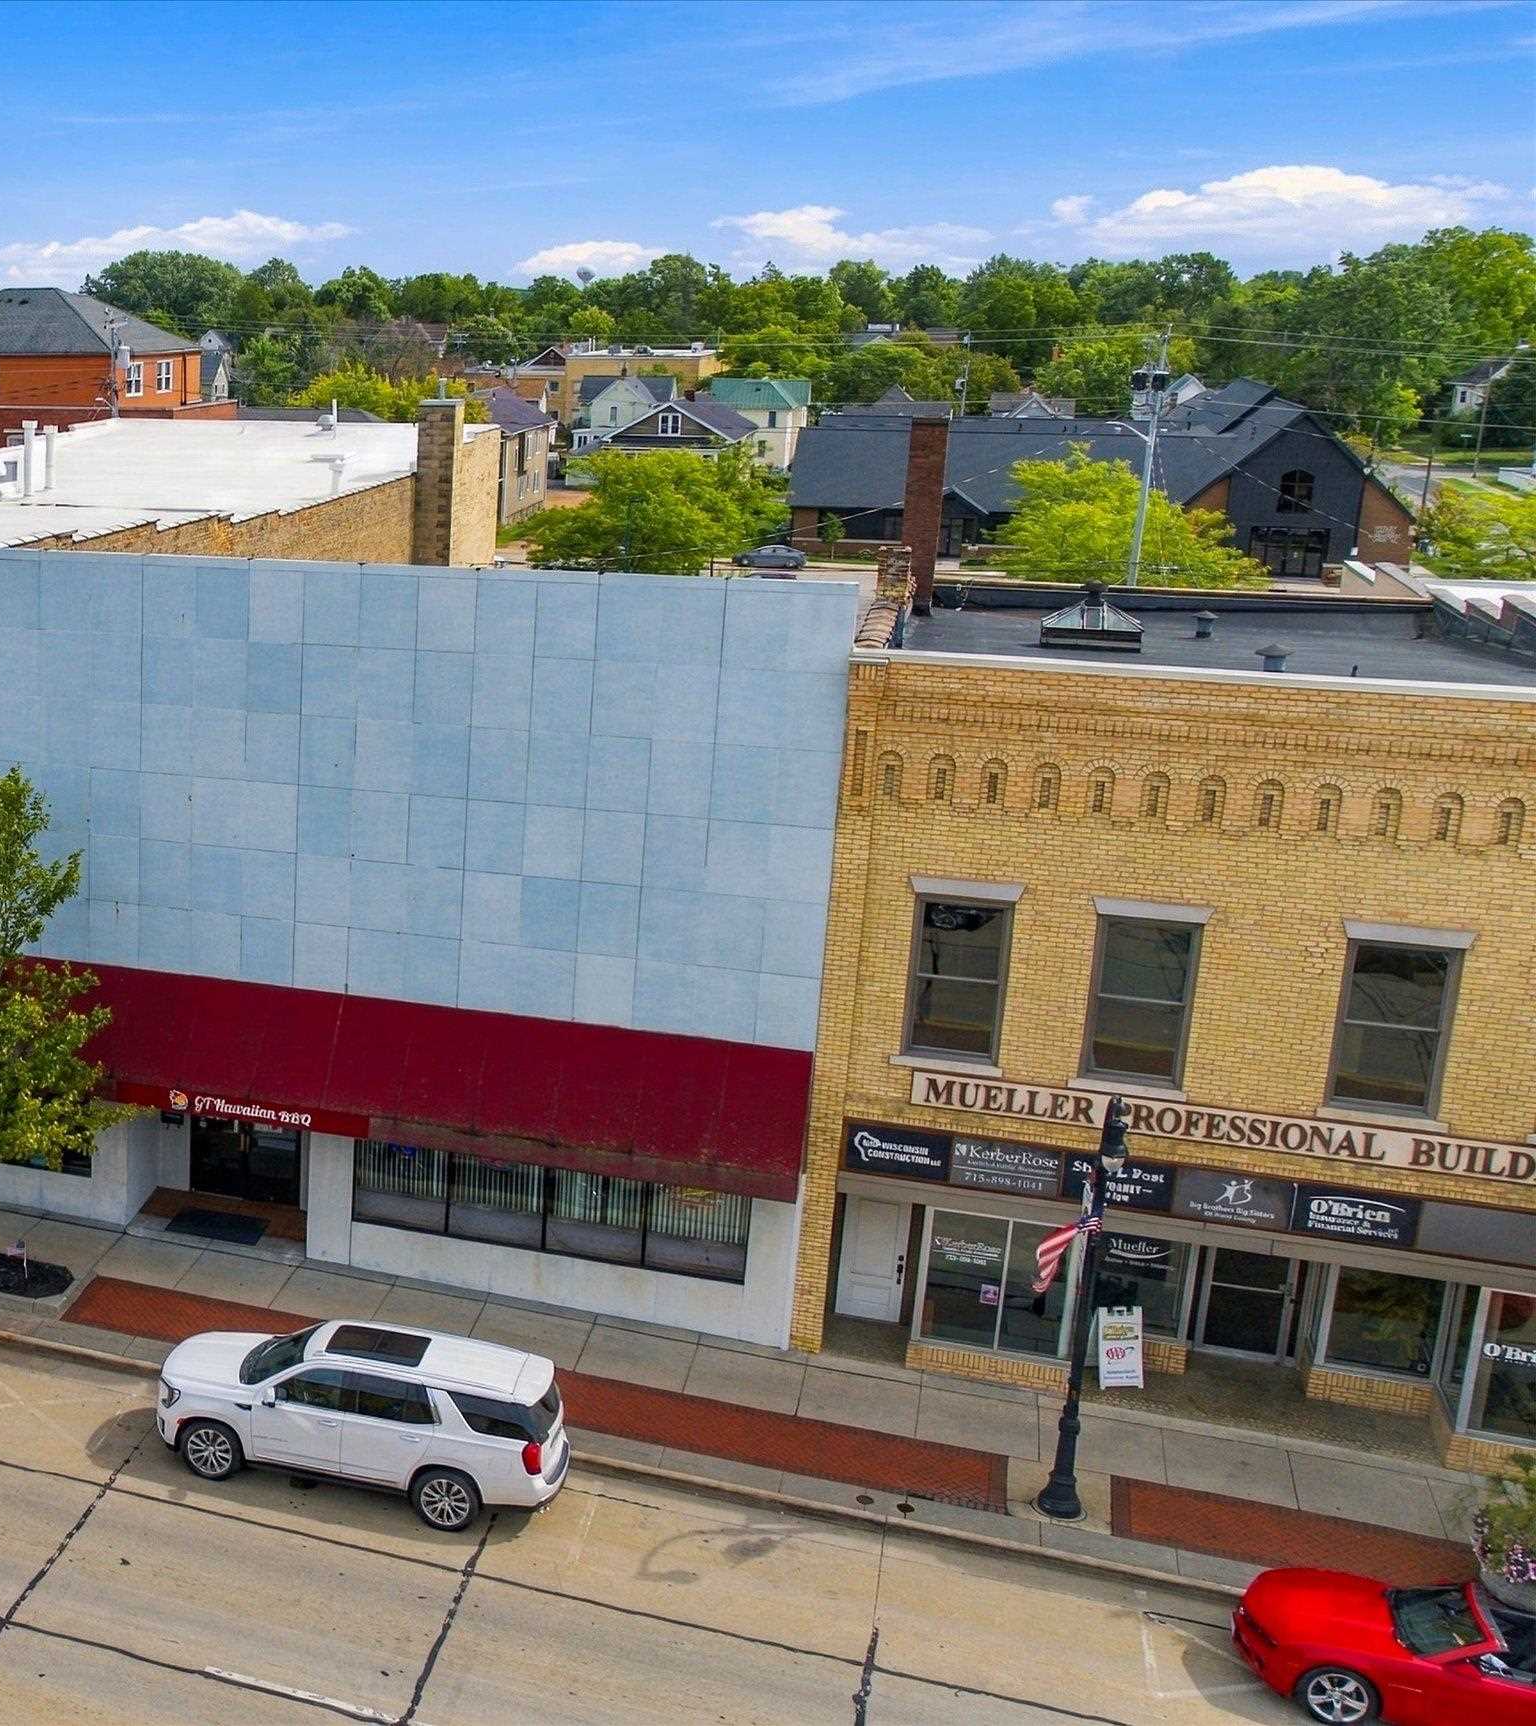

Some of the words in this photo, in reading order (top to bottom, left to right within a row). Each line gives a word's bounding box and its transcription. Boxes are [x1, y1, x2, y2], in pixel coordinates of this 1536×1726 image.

[925, 1077, 1095, 1124] MUELLER
[278, 1111, 312, 1127] BBQ
[867, 1149, 931, 1166] CONSTRUCTION
[969, 1144, 1059, 1169] KerberRose
[1189, 1200, 1202, 1211] Big
[1202, 1203, 1234, 1214] Brothers
[1310, 1199, 1391, 1223] O'Brien
[1307, 1219, 1355, 1233] Financial
